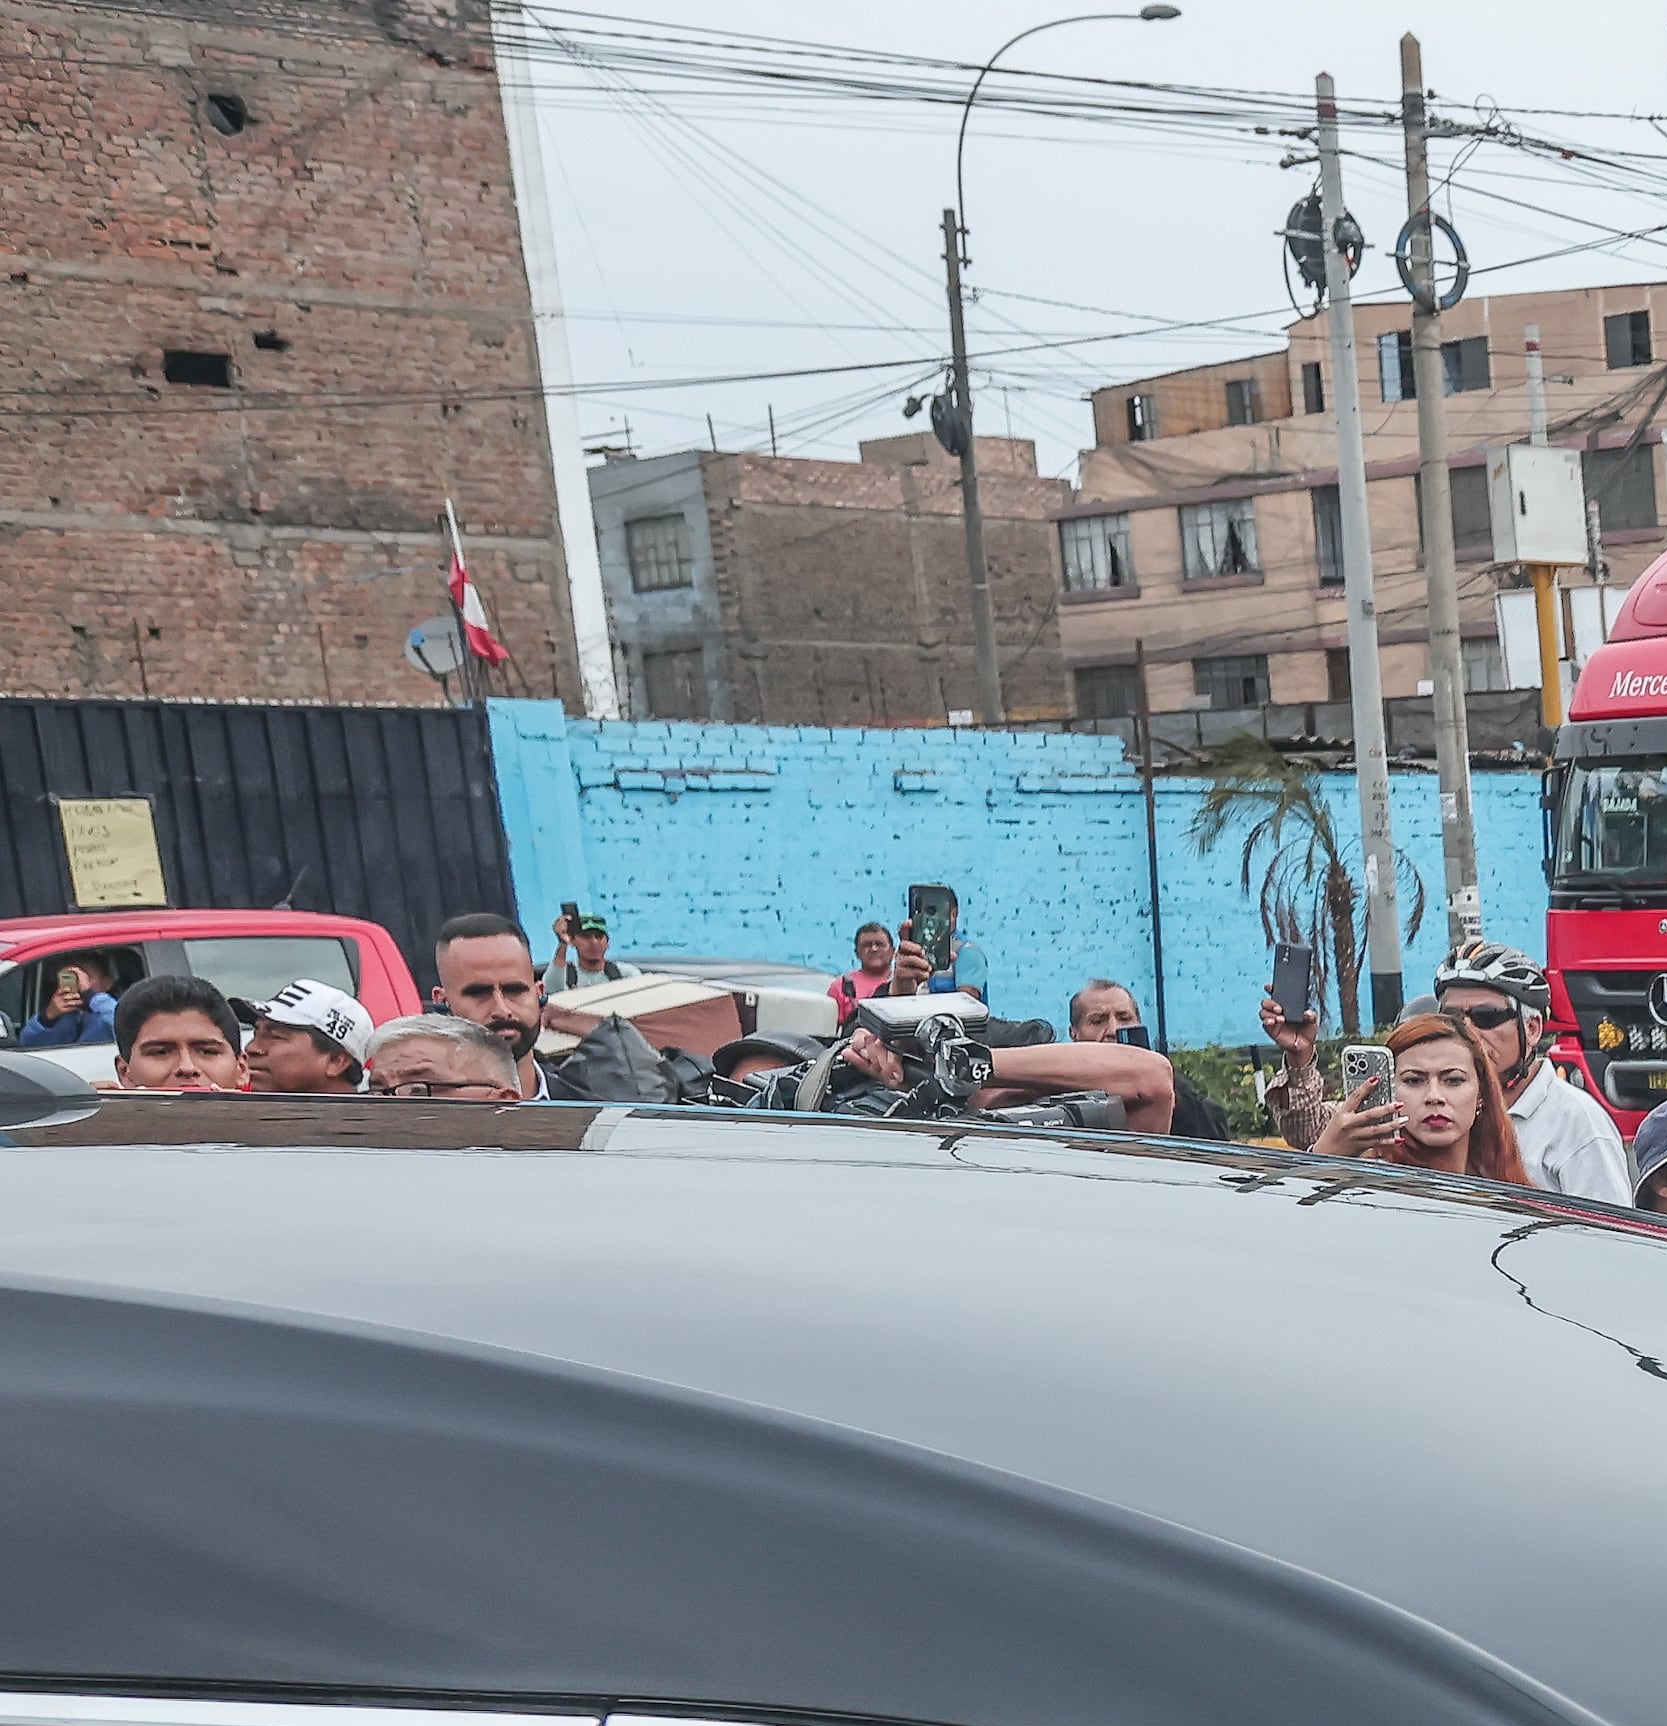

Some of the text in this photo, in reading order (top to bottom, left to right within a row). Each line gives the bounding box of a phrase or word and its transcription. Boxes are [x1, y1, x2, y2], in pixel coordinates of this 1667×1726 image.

[326, 1021, 347, 1040] 49
[972, 1063, 991, 1080] 67
[1043, 1119, 1064, 1127] SONY
